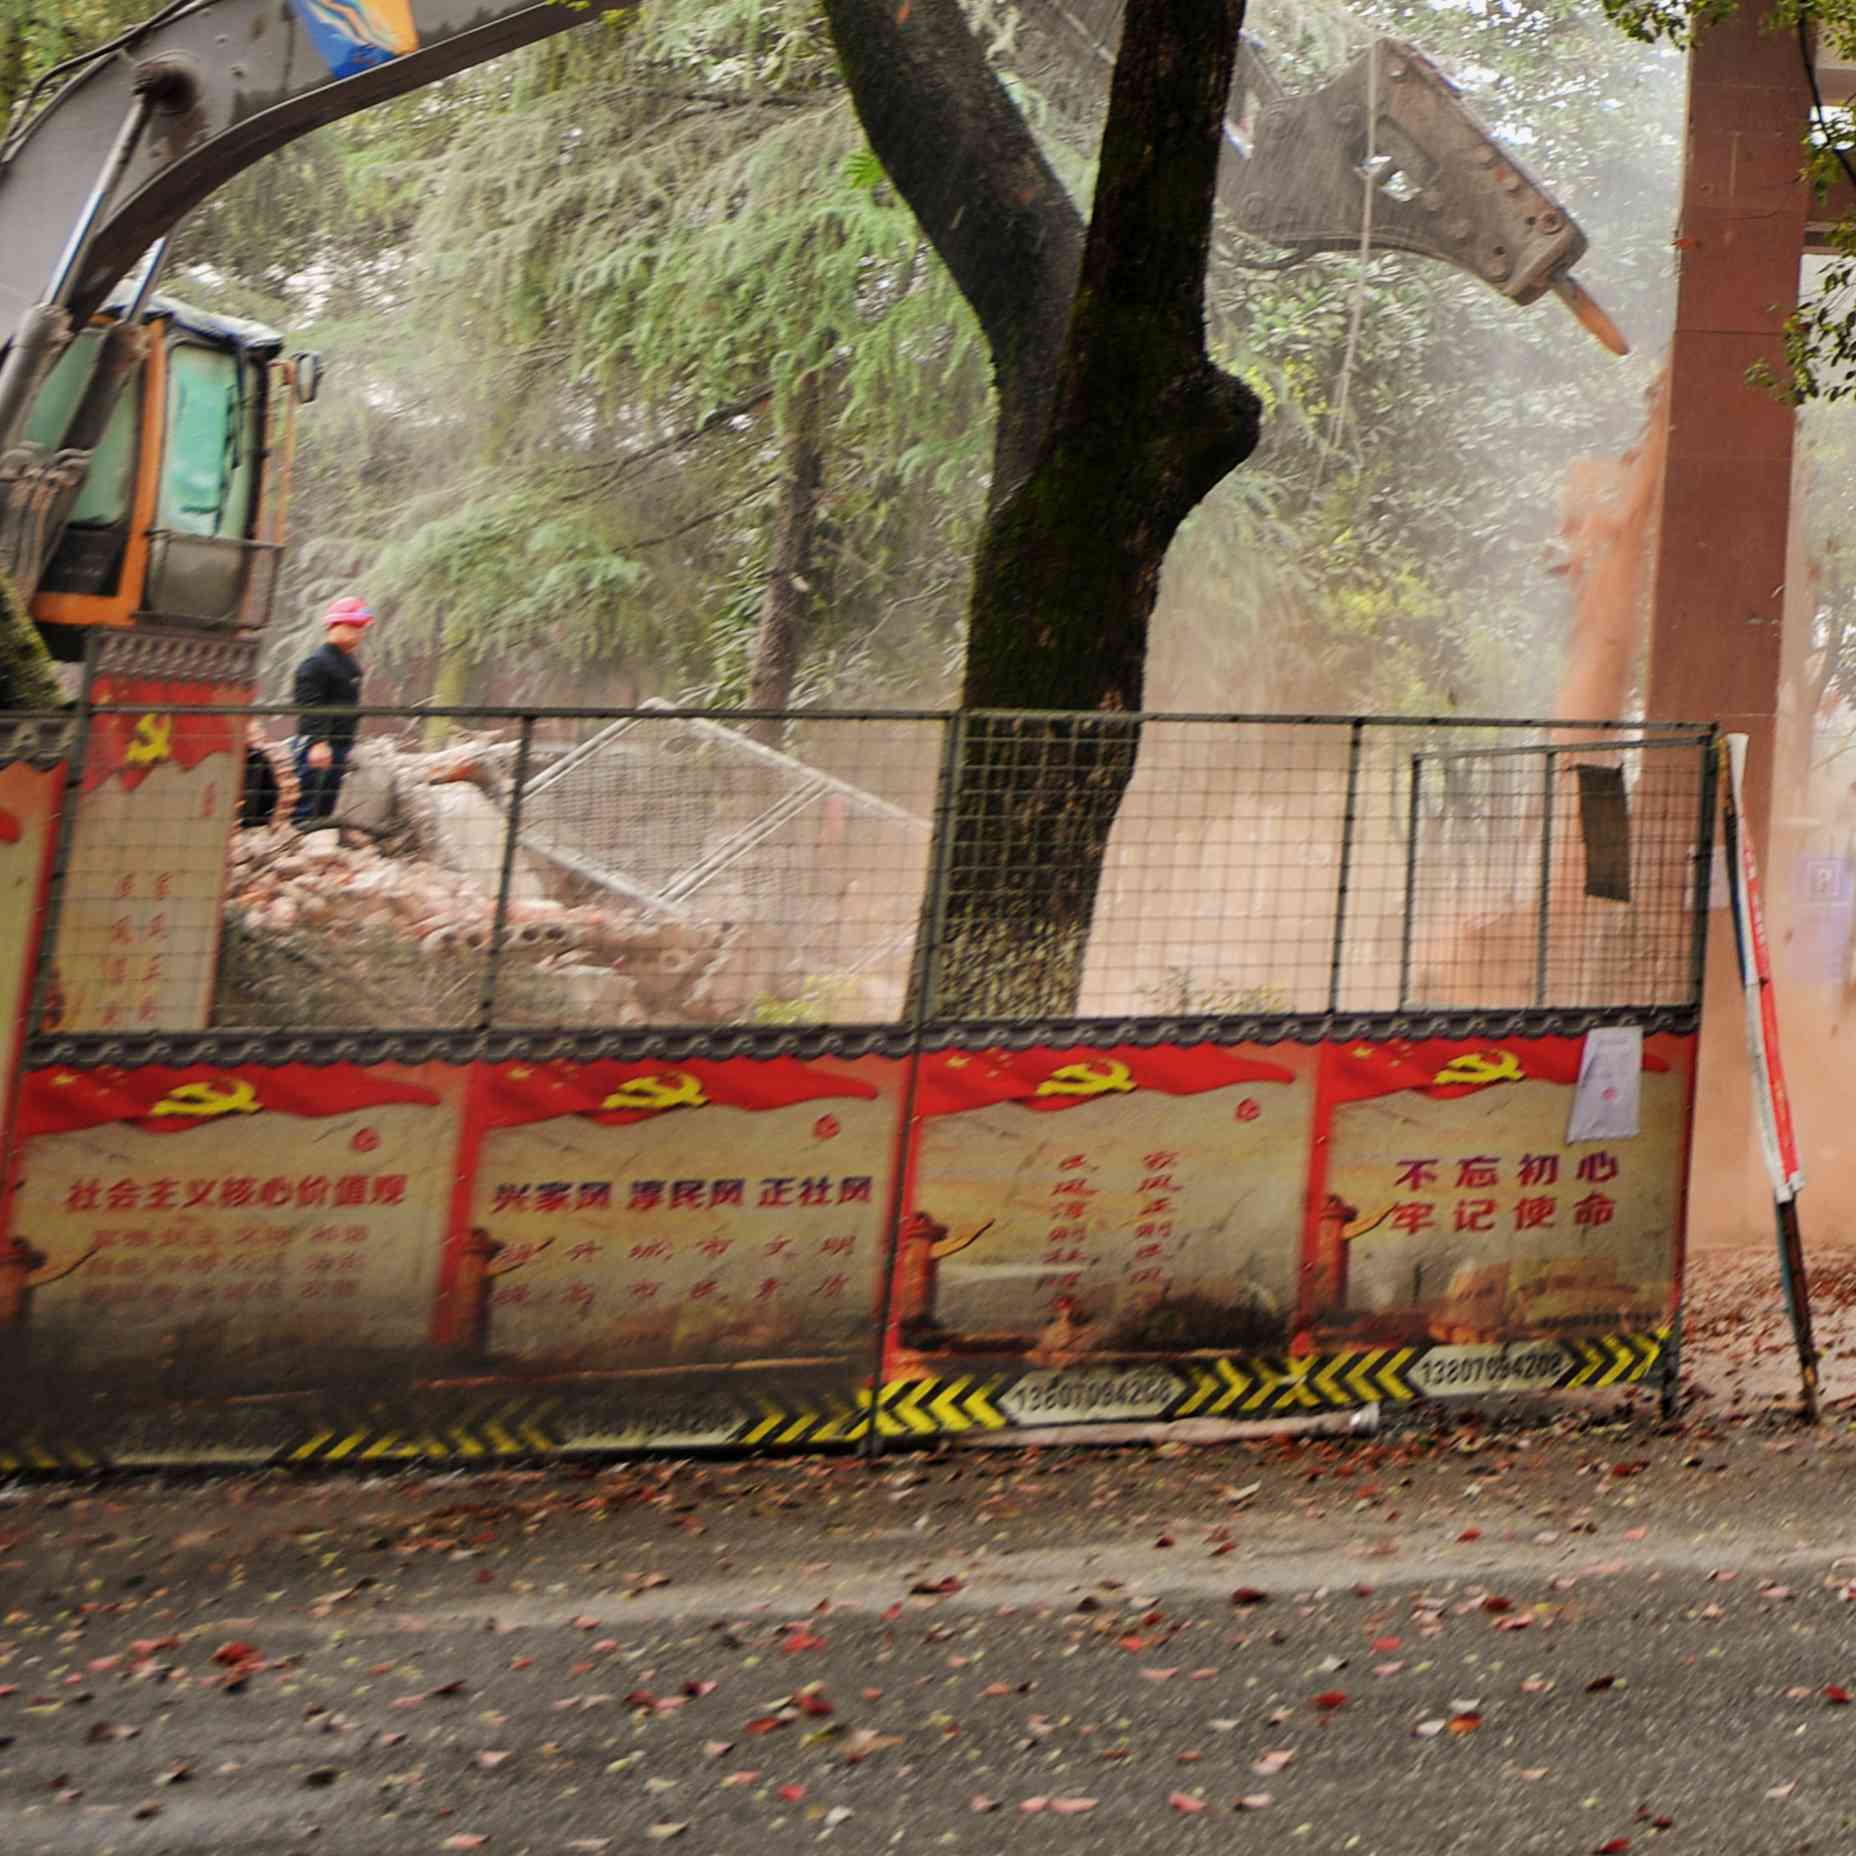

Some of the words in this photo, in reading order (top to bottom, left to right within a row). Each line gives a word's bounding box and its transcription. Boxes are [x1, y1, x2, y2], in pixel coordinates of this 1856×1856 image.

[1393, 1150, 1620, 1192] 不忘初心
[64, 1173, 408, 1211] 社会主义核心价值观
[756, 1174, 874, 1210] 正社风
[1389, 1190, 1617, 1235] 牢记使命
